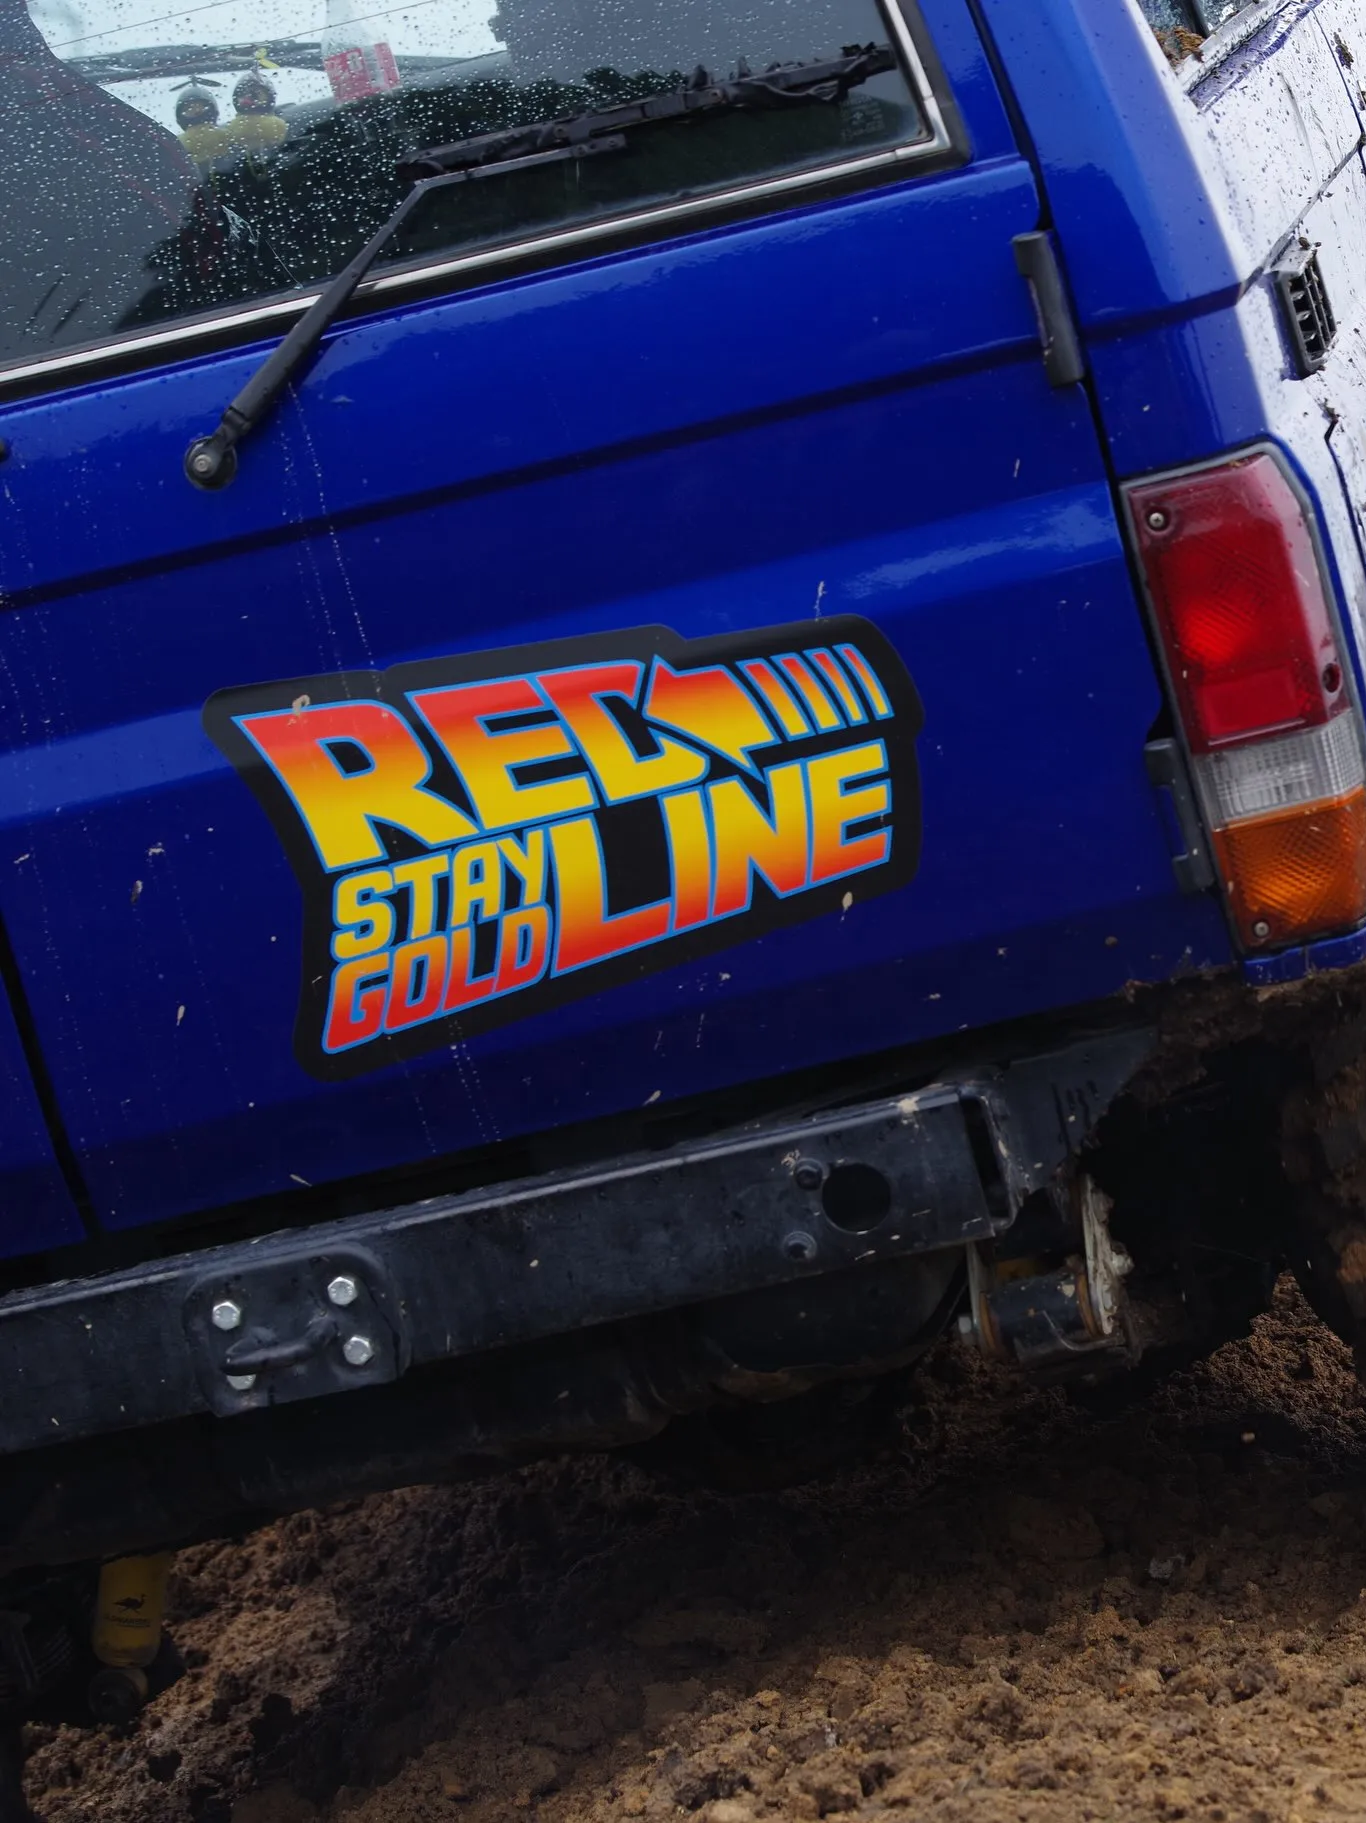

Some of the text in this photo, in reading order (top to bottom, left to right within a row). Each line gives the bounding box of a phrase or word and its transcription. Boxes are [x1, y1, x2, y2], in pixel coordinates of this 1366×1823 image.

[331, 828, 550, 963] STAY
[548, 738, 893, 979] LINE
[321, 902, 553, 1054] GOLD
